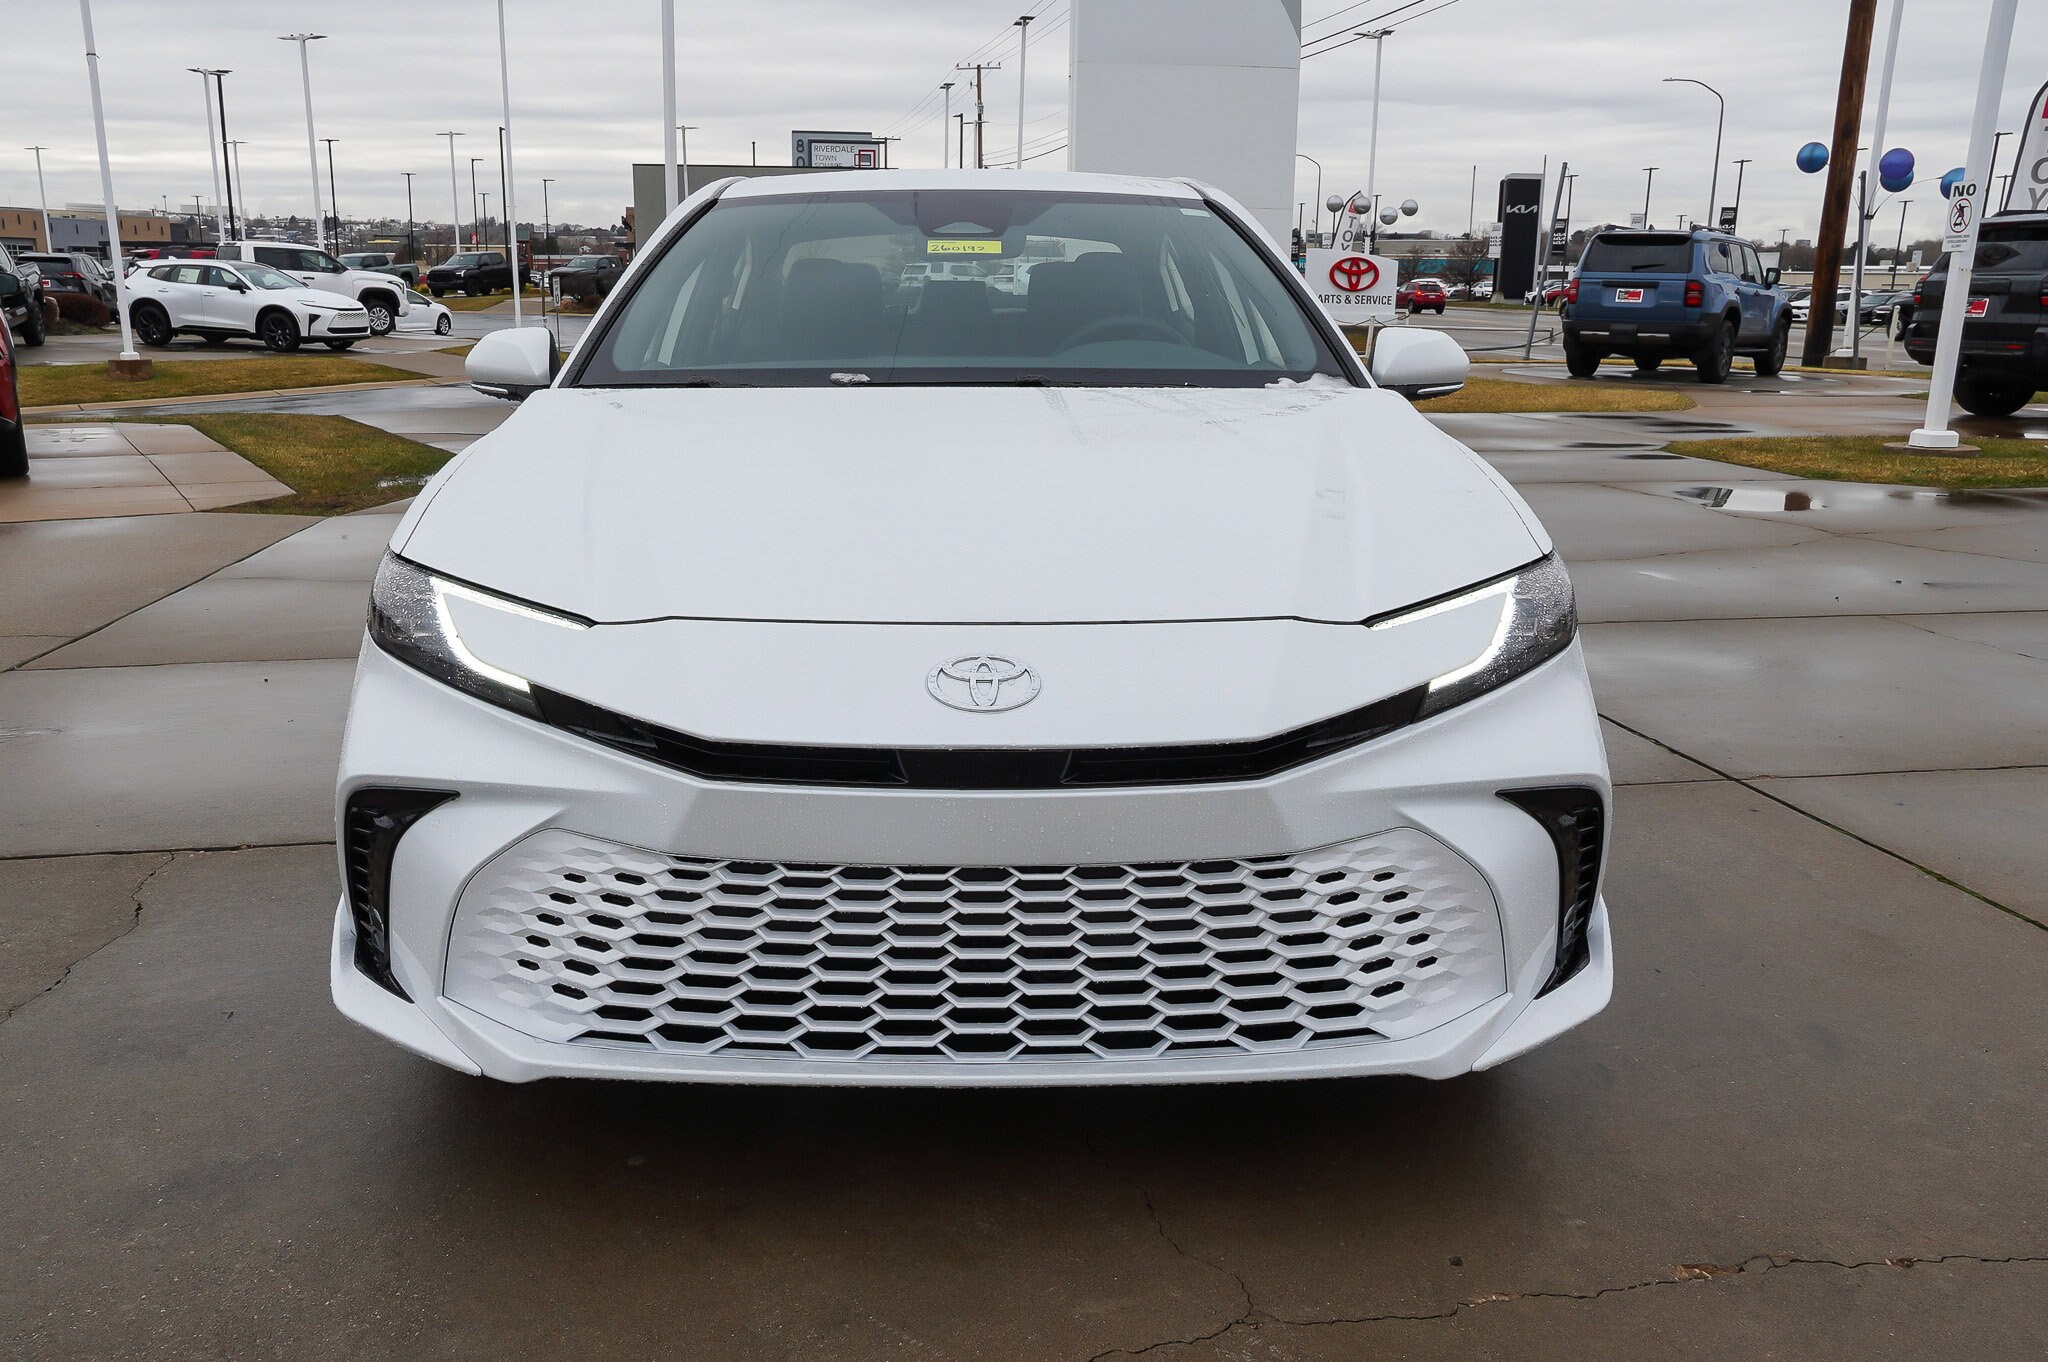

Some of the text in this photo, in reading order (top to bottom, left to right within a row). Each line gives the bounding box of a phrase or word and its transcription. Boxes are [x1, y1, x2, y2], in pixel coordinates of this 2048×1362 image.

[1953, 183, 1977, 197] NO
[1506, 204, 1538, 213] KIA
[1341, 216, 1357, 250] TOY
[1318, 294, 1393, 306] ARTS & SERVICE
